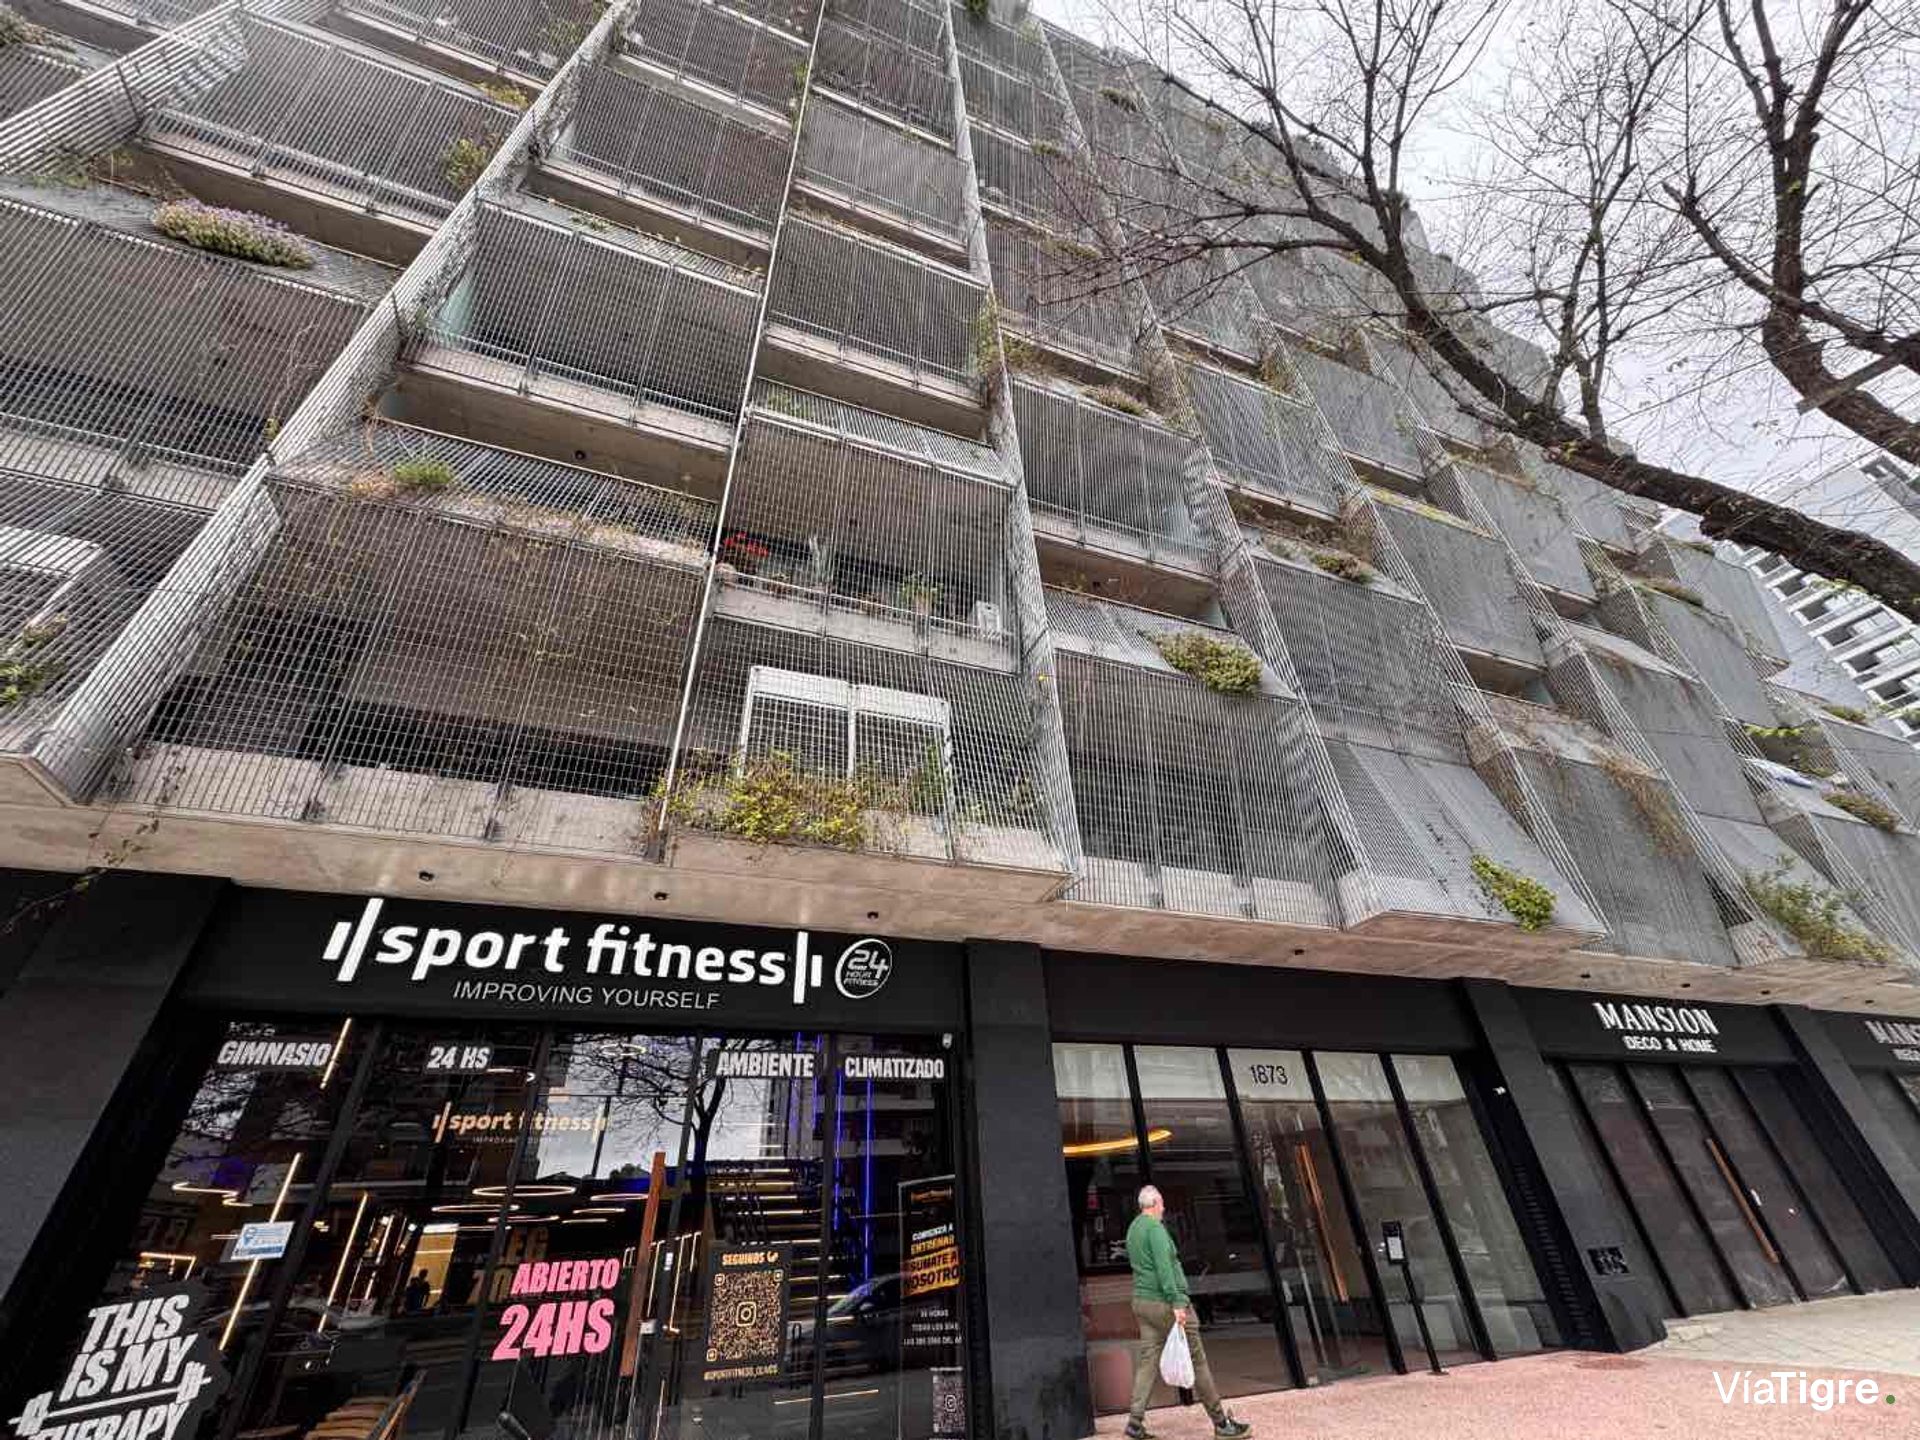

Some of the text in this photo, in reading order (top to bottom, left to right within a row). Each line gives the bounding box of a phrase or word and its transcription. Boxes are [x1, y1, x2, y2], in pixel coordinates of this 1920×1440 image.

[374, 923, 787, 985] sport fitness
[848, 949, 888, 979] 24
[453, 981, 720, 1009] IMPROVING YOURSELF
[1592, 1002, 1719, 1034] MANSION
[217, 1041, 332, 1066] GIMNASIO
[426, 1046, 491, 1069] 24 HS
[1623, 1035, 1718, 1053] DECO & HOME
[715, 1052, 945, 1079] AMBIENTE CLIMATIZADO
[1250, 1065, 1288, 1085] 1873
[449, 1111, 514, 1136] sport
[722, 1252, 766, 1266] SEGUINOS
[510, 1258, 620, 1295] ABIERTO
[81, 1295, 190, 1354] THIS
[491, 1298, 615, 1361] 24HS
[58, 1333, 199, 1402] IS MY
